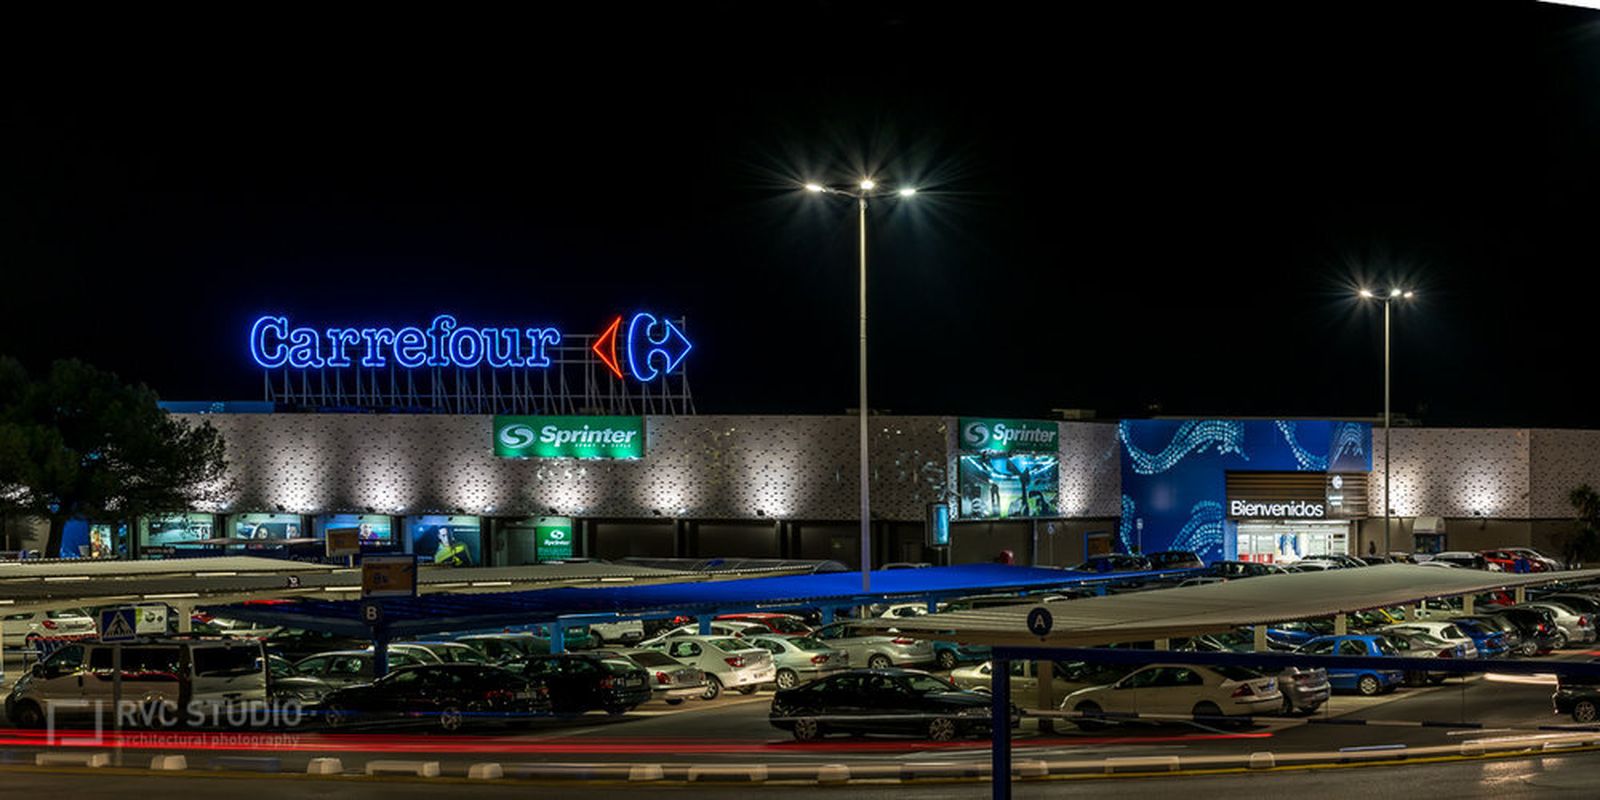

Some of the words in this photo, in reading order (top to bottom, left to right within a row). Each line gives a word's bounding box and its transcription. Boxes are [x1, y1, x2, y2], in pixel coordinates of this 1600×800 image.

[250, 314, 561, 369] Carrefour
[540, 424, 637, 448] Sprinter
[992, 423, 1057, 446] Sprinter
[1231, 500, 1324, 518] Bienvenidos
[366, 605, 378, 621] B
[1033, 613, 1046, 628] A
